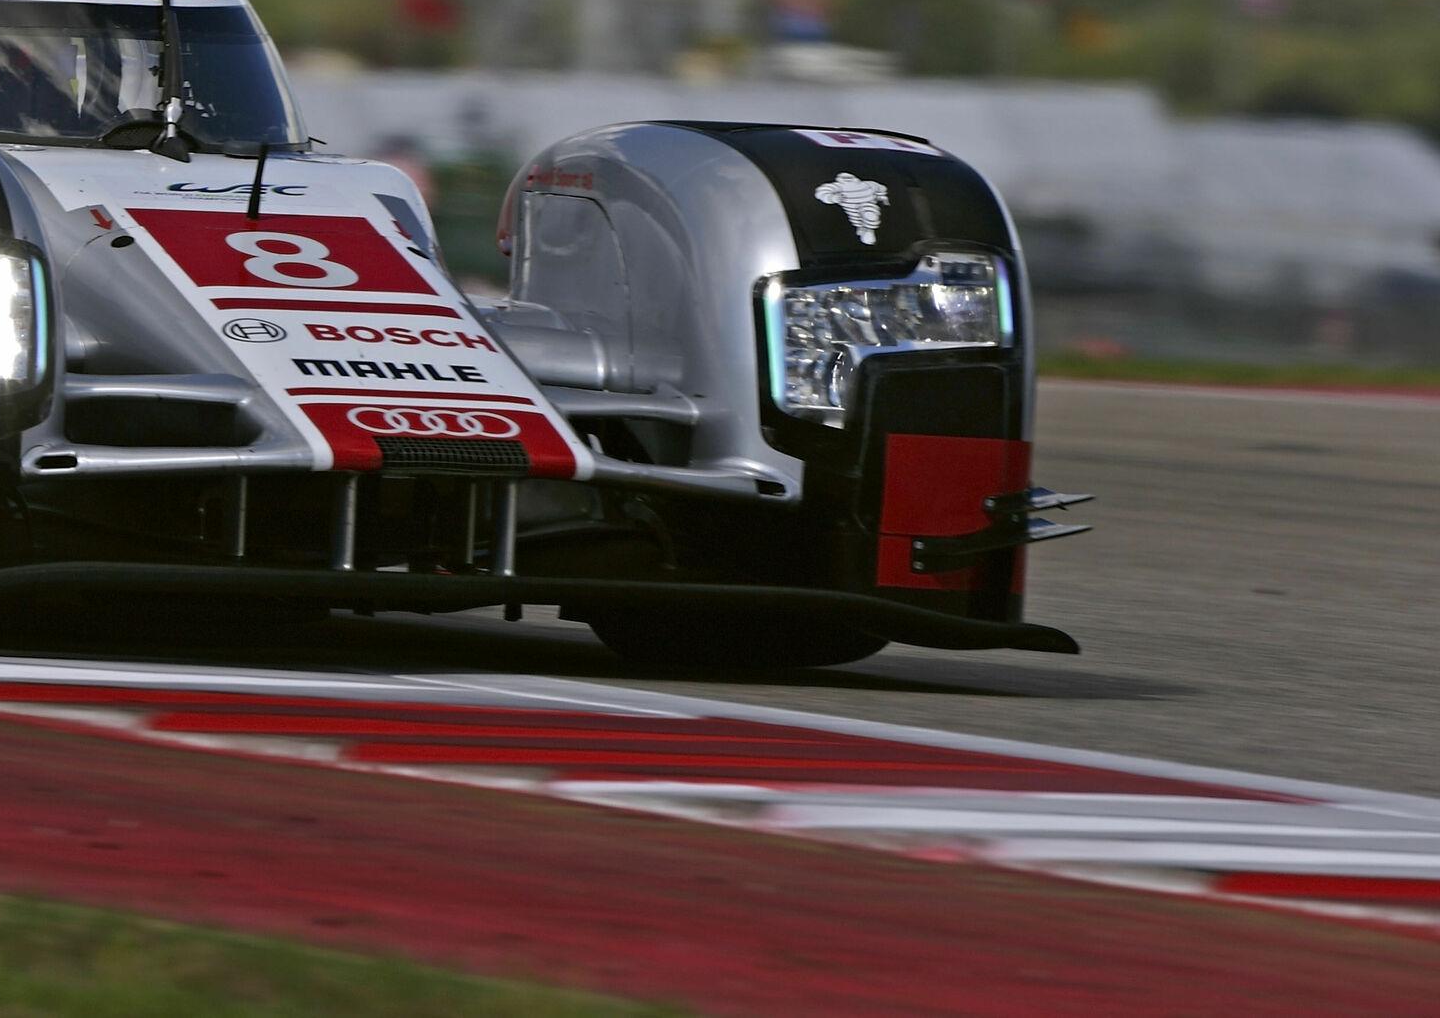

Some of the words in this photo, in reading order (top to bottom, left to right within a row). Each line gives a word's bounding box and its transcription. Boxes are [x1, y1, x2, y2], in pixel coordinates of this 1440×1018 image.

[167, 182, 309, 196] WEC
[225, 231, 360, 288] 8
[304, 324, 499, 353] BOSCH
[291, 358, 489, 383] MAHLE
